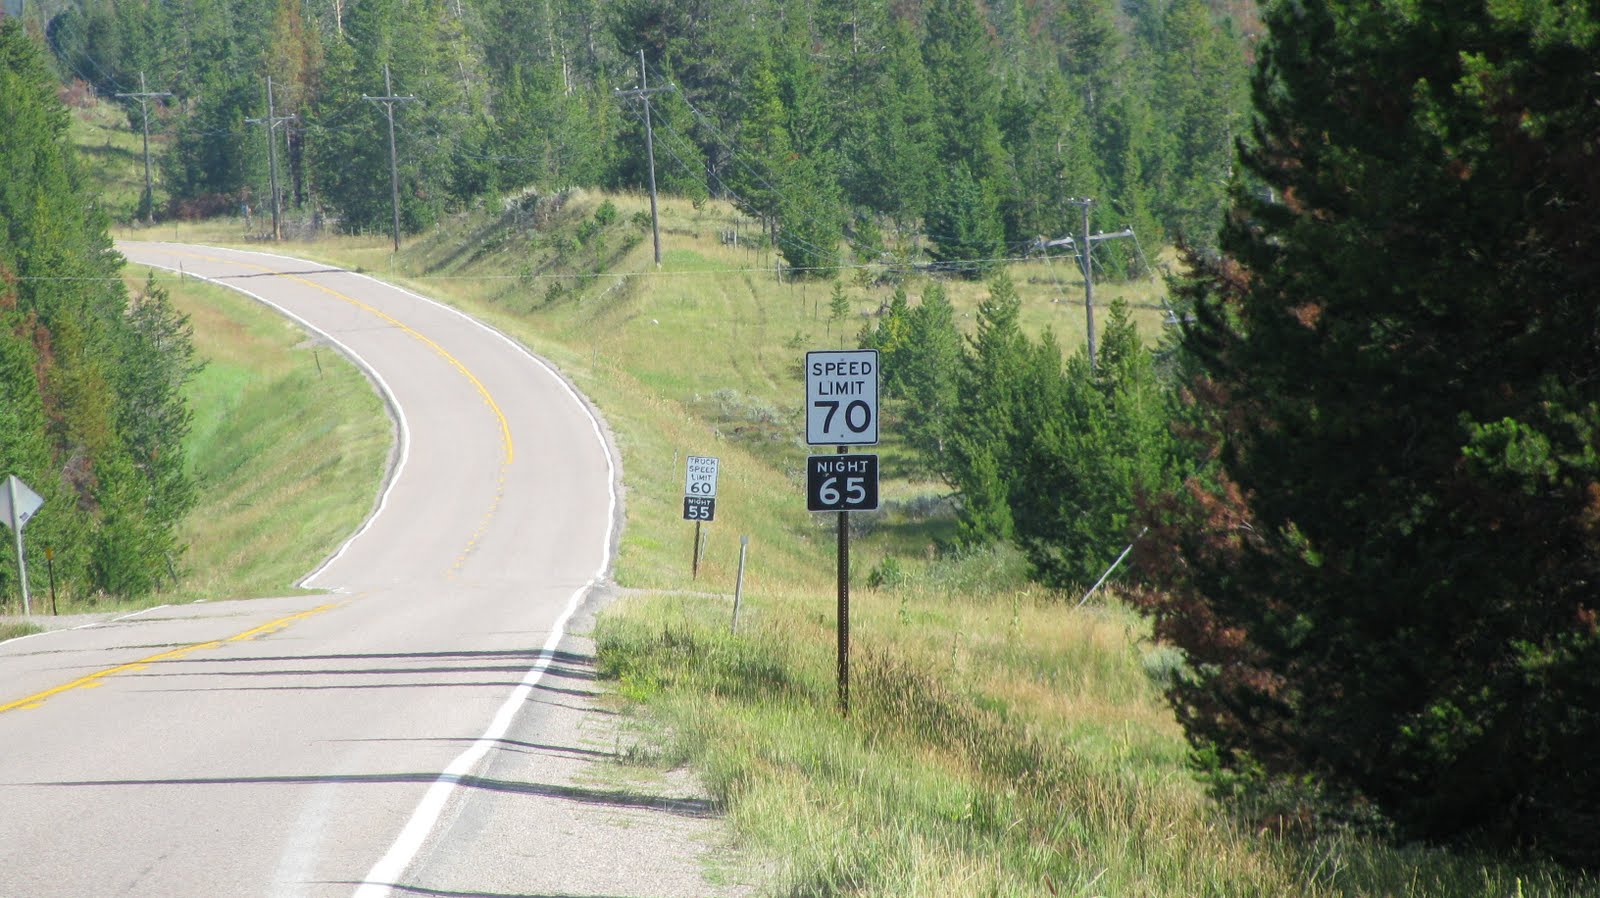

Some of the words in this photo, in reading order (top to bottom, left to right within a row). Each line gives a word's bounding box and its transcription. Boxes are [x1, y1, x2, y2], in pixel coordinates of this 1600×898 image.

[813, 362, 872, 376] SPEED
[819, 381, 864, 395] LIMIT
[814, 400, 871, 433] 70
[817, 460, 868, 473] NIGHT
[690, 482, 711, 494] 60
[819, 477, 866, 505] 65
[688, 505, 709, 518] 55
